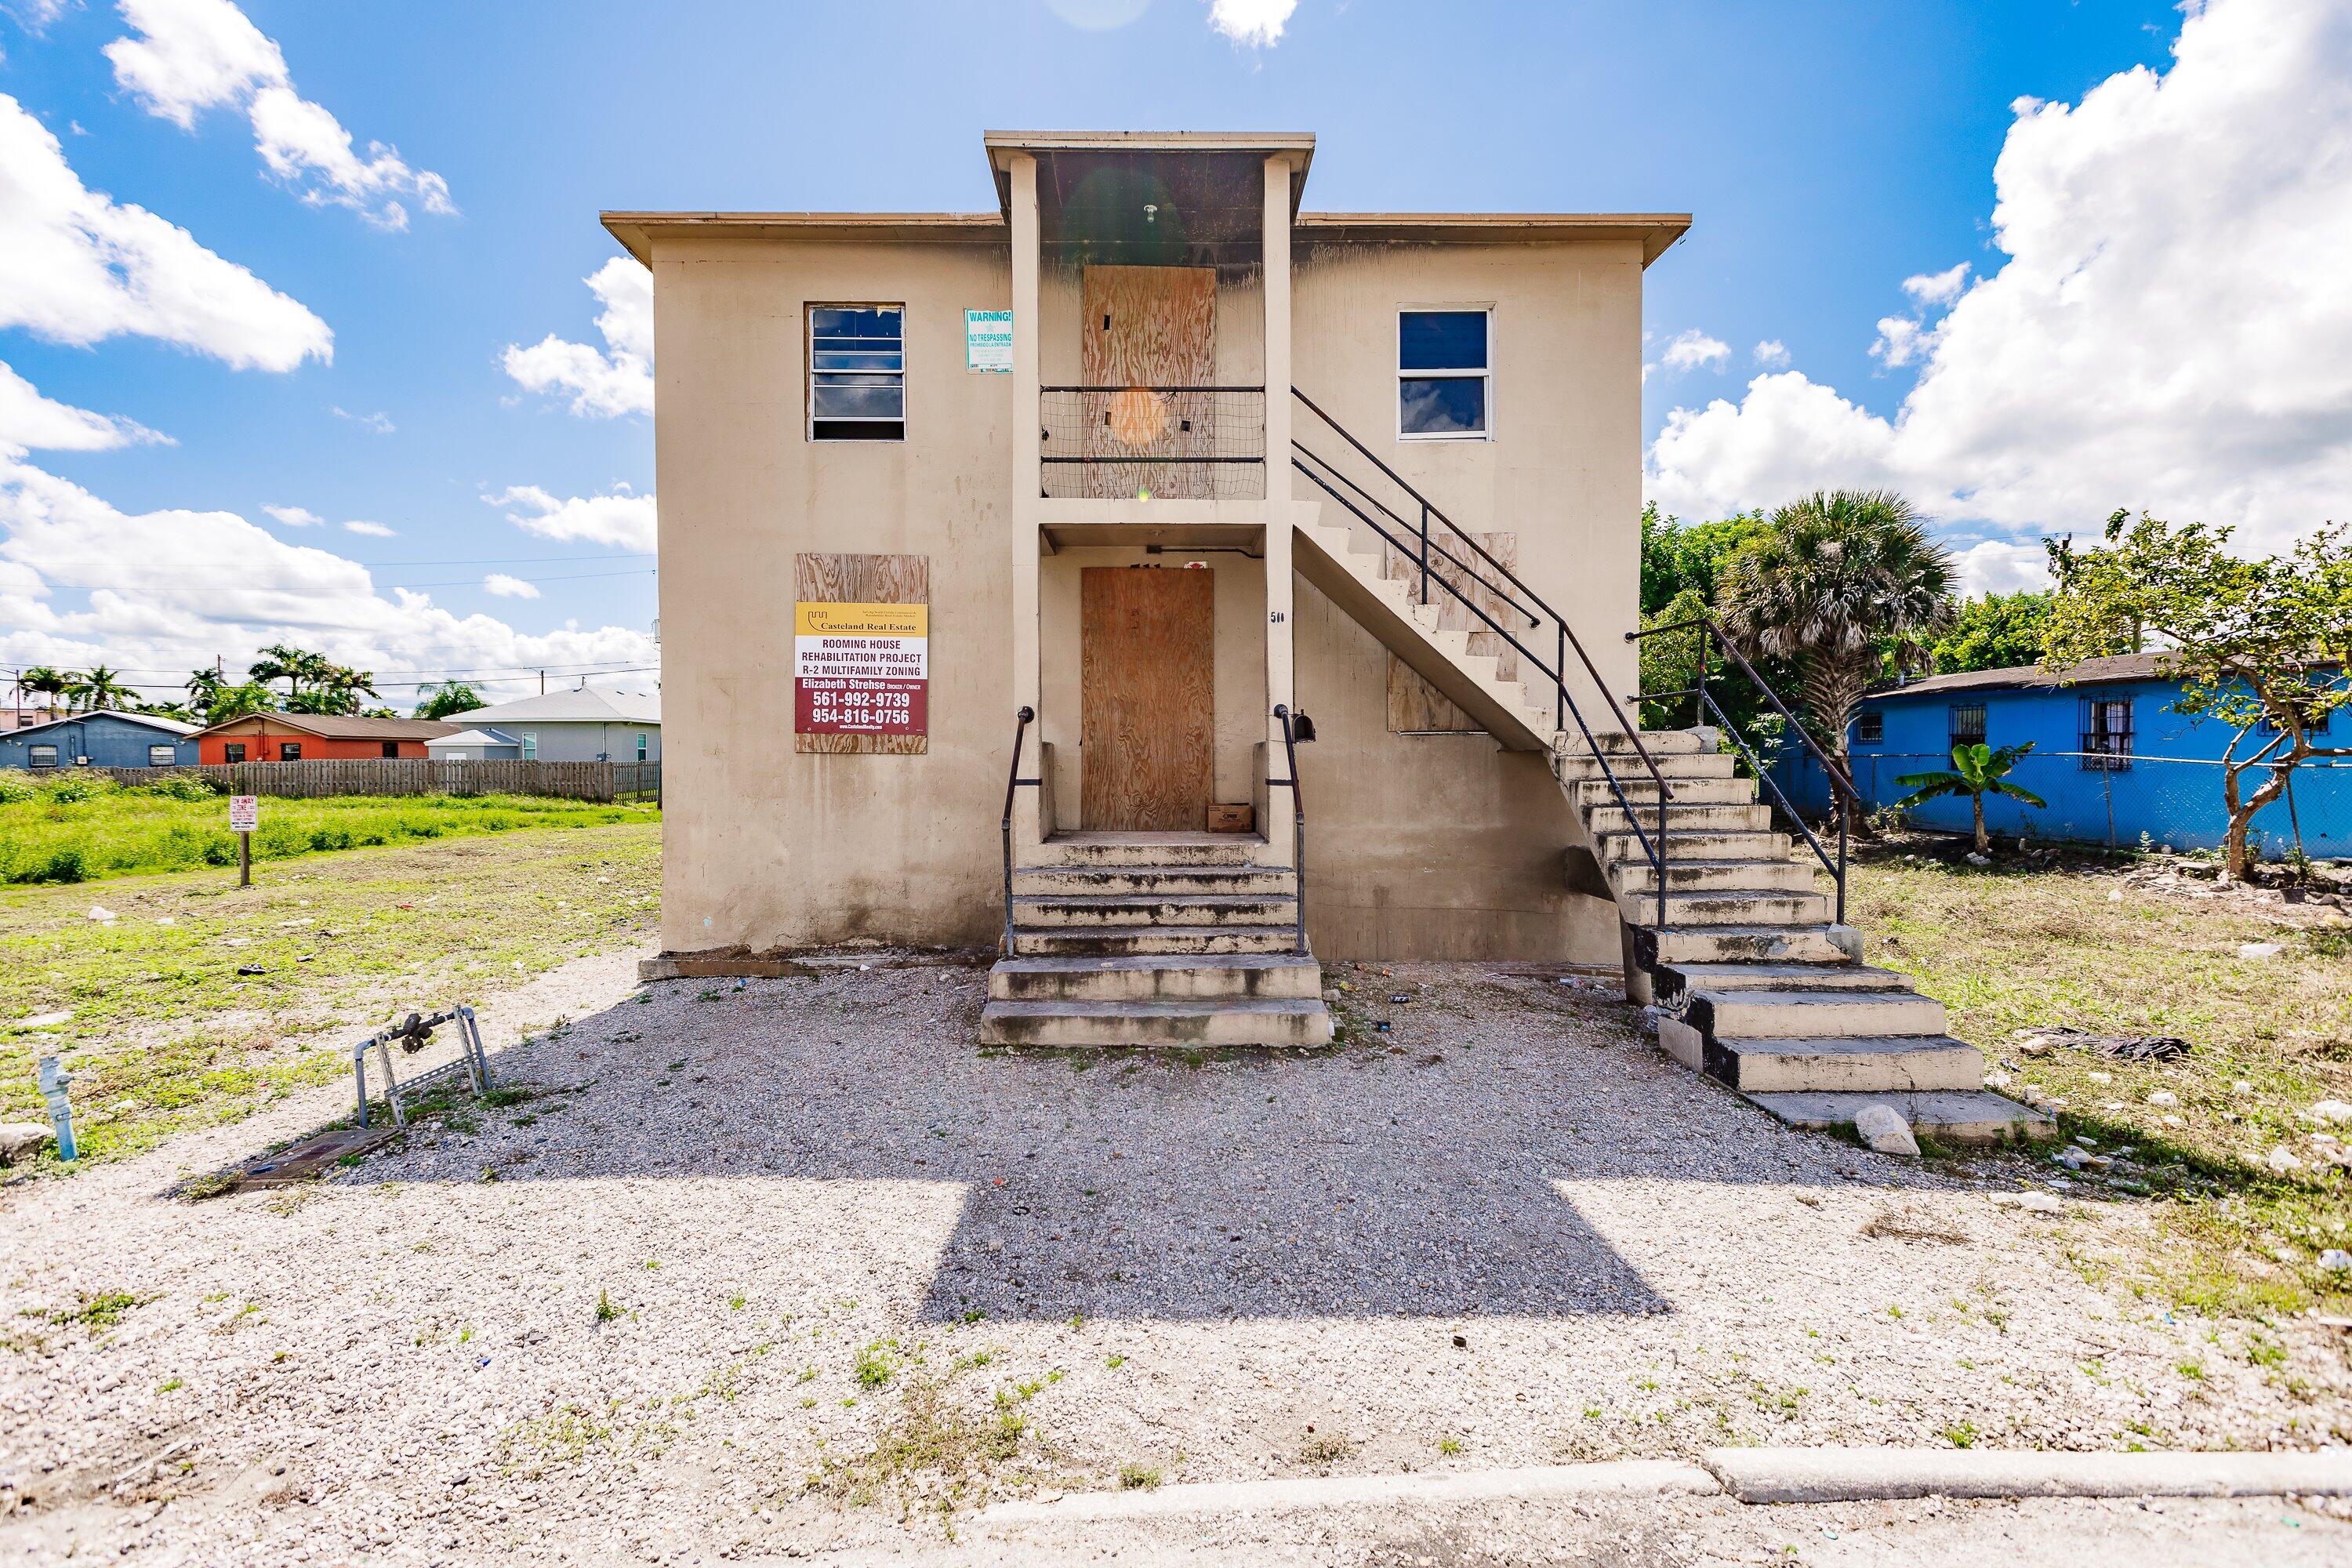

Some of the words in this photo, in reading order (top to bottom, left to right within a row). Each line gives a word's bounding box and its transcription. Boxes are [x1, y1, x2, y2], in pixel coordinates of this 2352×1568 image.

[969, 312, 1011, 321] WARNING!
[978, 333, 1011, 342] TRESPASSING
[1270, 612, 1284, 623] 511
[821, 622, 864, 630] Casteland
[822, 639, 866, 648] ROOMING
[869, 640, 901, 649] HOUSE
[802, 652, 877, 662] REHABILITATION
[880, 654, 921, 663] PROJECT
[803, 665, 819, 674] R-2
[822, 666, 883, 675] MULTIFAMILY
[886, 666, 920, 676] ZONING
[802, 678, 847, 689] Elizabeth
[849, 679, 886, 690] Strehse
[813, 691, 910, 708] 561-992-9739
[812, 708, 909, 724] 954-816-0756
